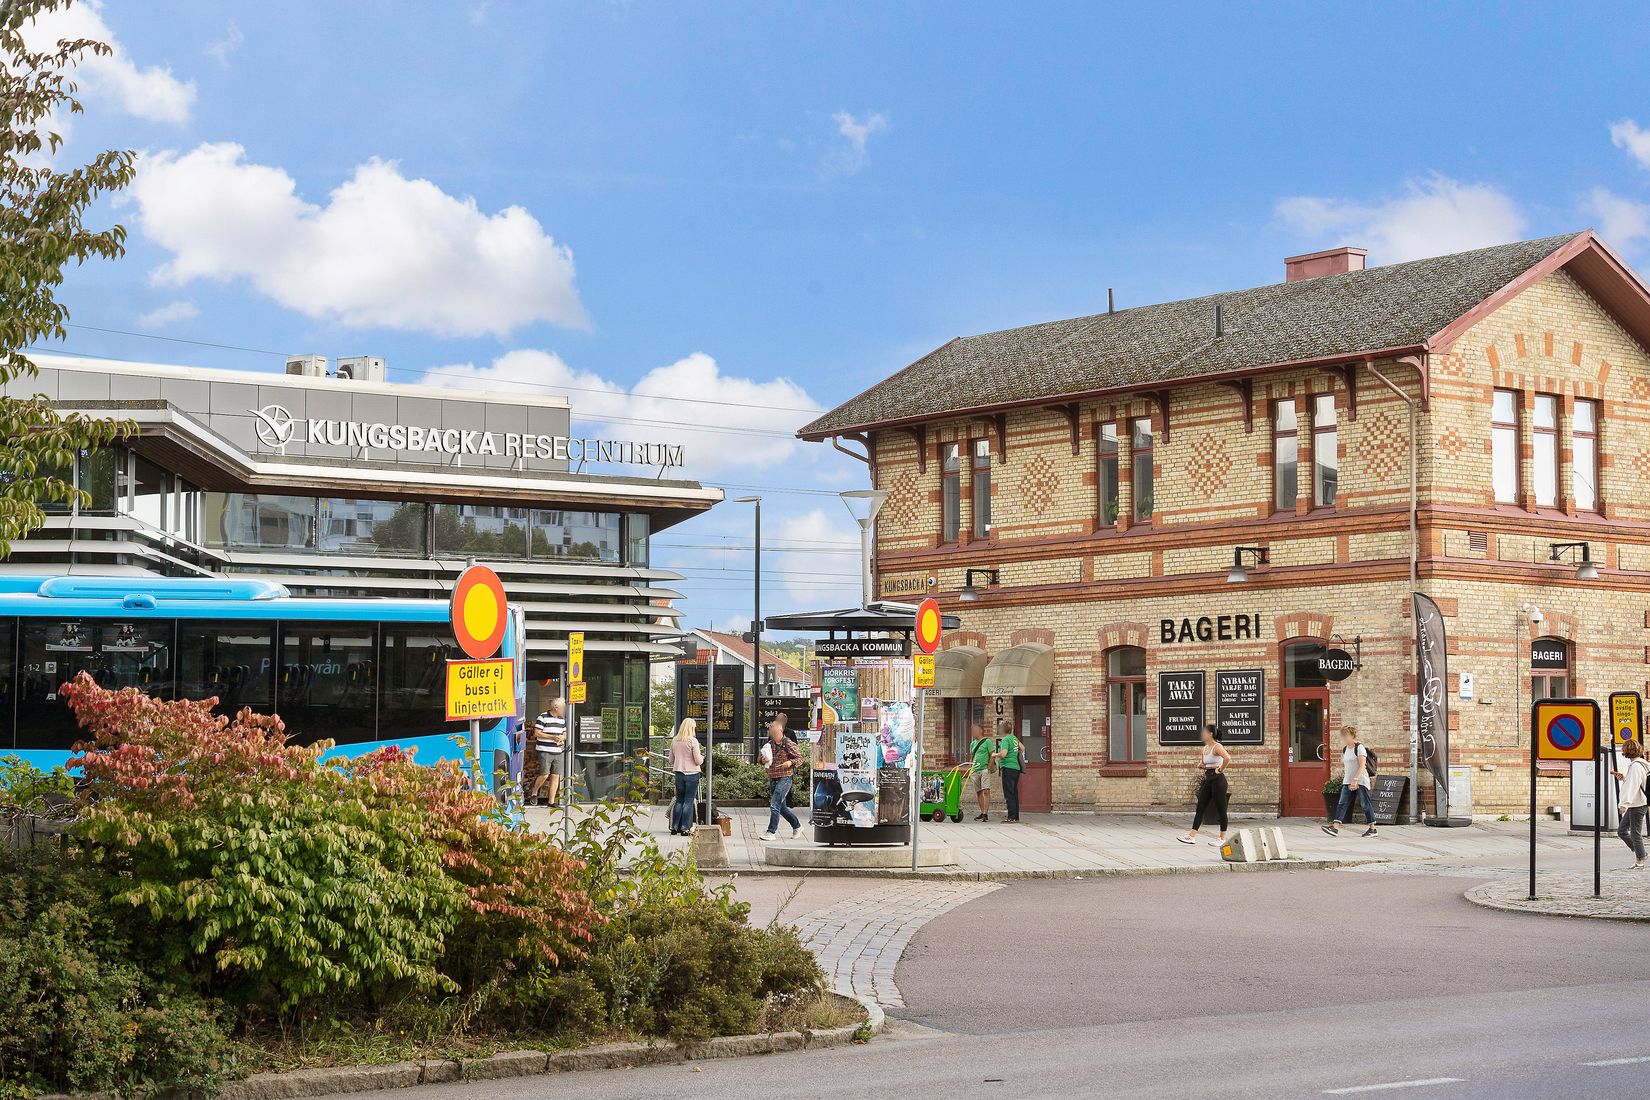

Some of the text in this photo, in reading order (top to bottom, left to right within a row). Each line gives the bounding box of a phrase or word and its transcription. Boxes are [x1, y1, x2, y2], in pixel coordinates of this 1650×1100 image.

[306, 418, 686, 467] KUNGSBACKA RESECENTRUM
[884, 578, 925, 593] KUNGSBACKA
[1161, 614, 1260, 643] BAGERI
[862, 643, 903, 651] KOMMUN
[1532, 651, 1563, 661] BAGERI
[1318, 658, 1353, 670] BAGERI
[459, 665, 504, 680] Gäller ej
[465, 683, 497, 696] buss i
[1168, 680, 1195, 691] TAKE
[1168, 690, 1195, 700] AWAY
[454, 699, 508, 716] linjetrafik
[1221, 719, 1257, 727] SMÖRGÅSAR
